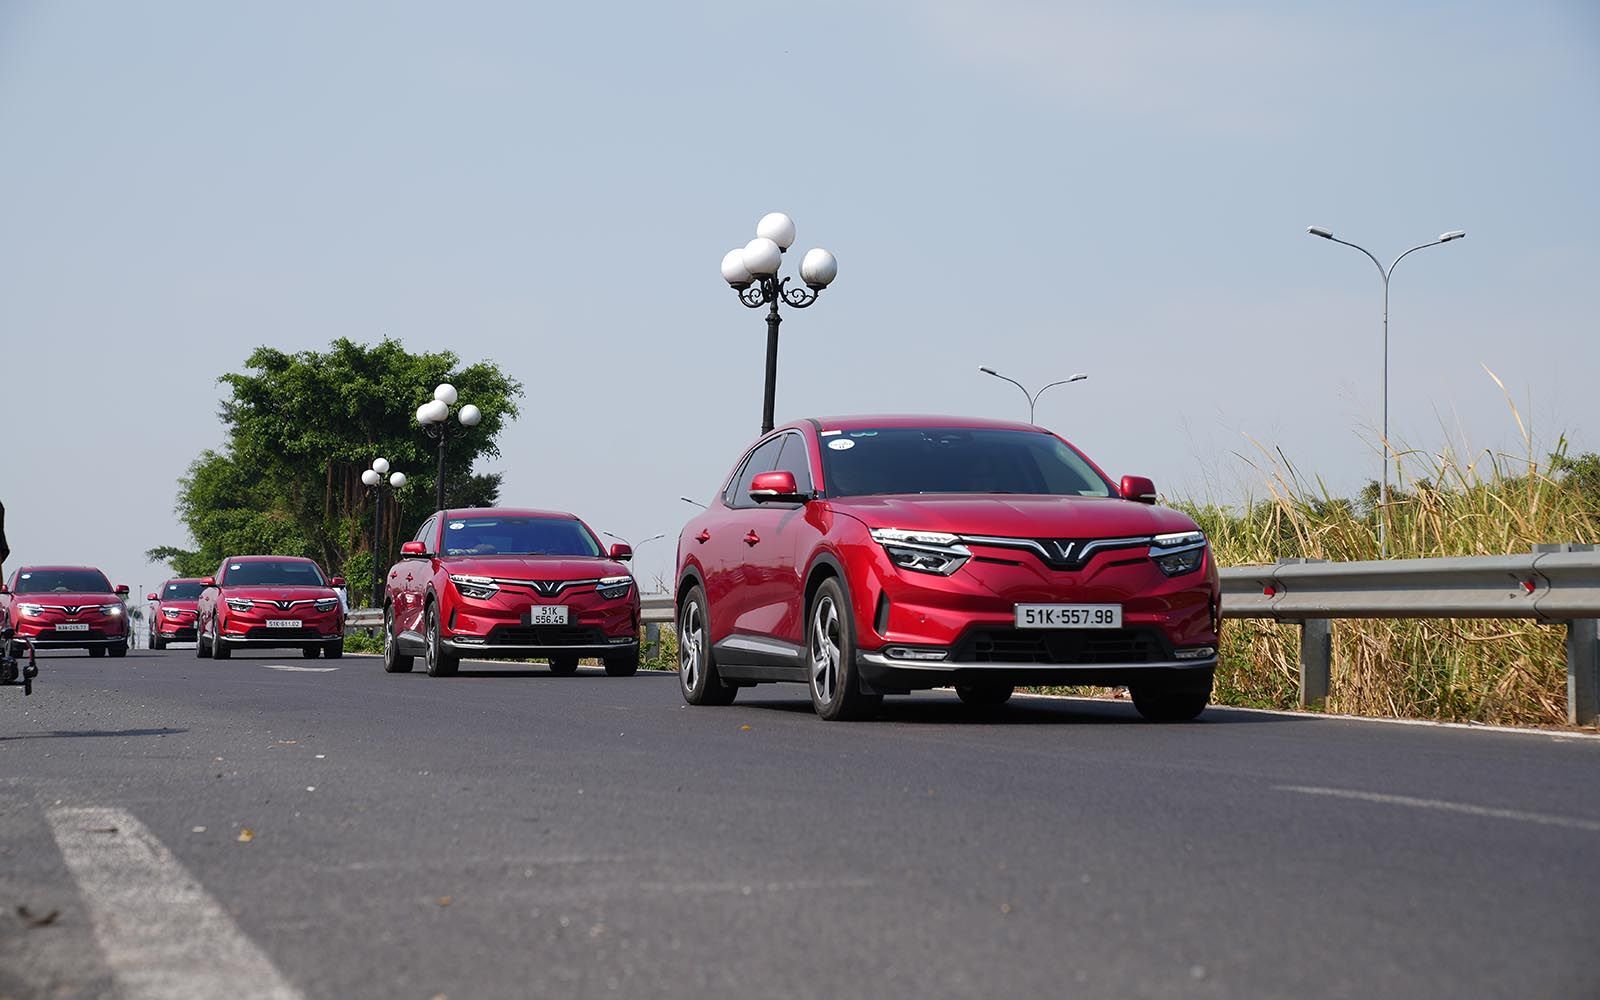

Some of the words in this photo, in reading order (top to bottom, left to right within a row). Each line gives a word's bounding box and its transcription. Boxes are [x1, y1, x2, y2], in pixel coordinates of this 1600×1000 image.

[541, 606, 558, 615] 51K
[535, 615, 564, 624] 556.45
[1025, 608, 1114, 624] 51K-557.98
